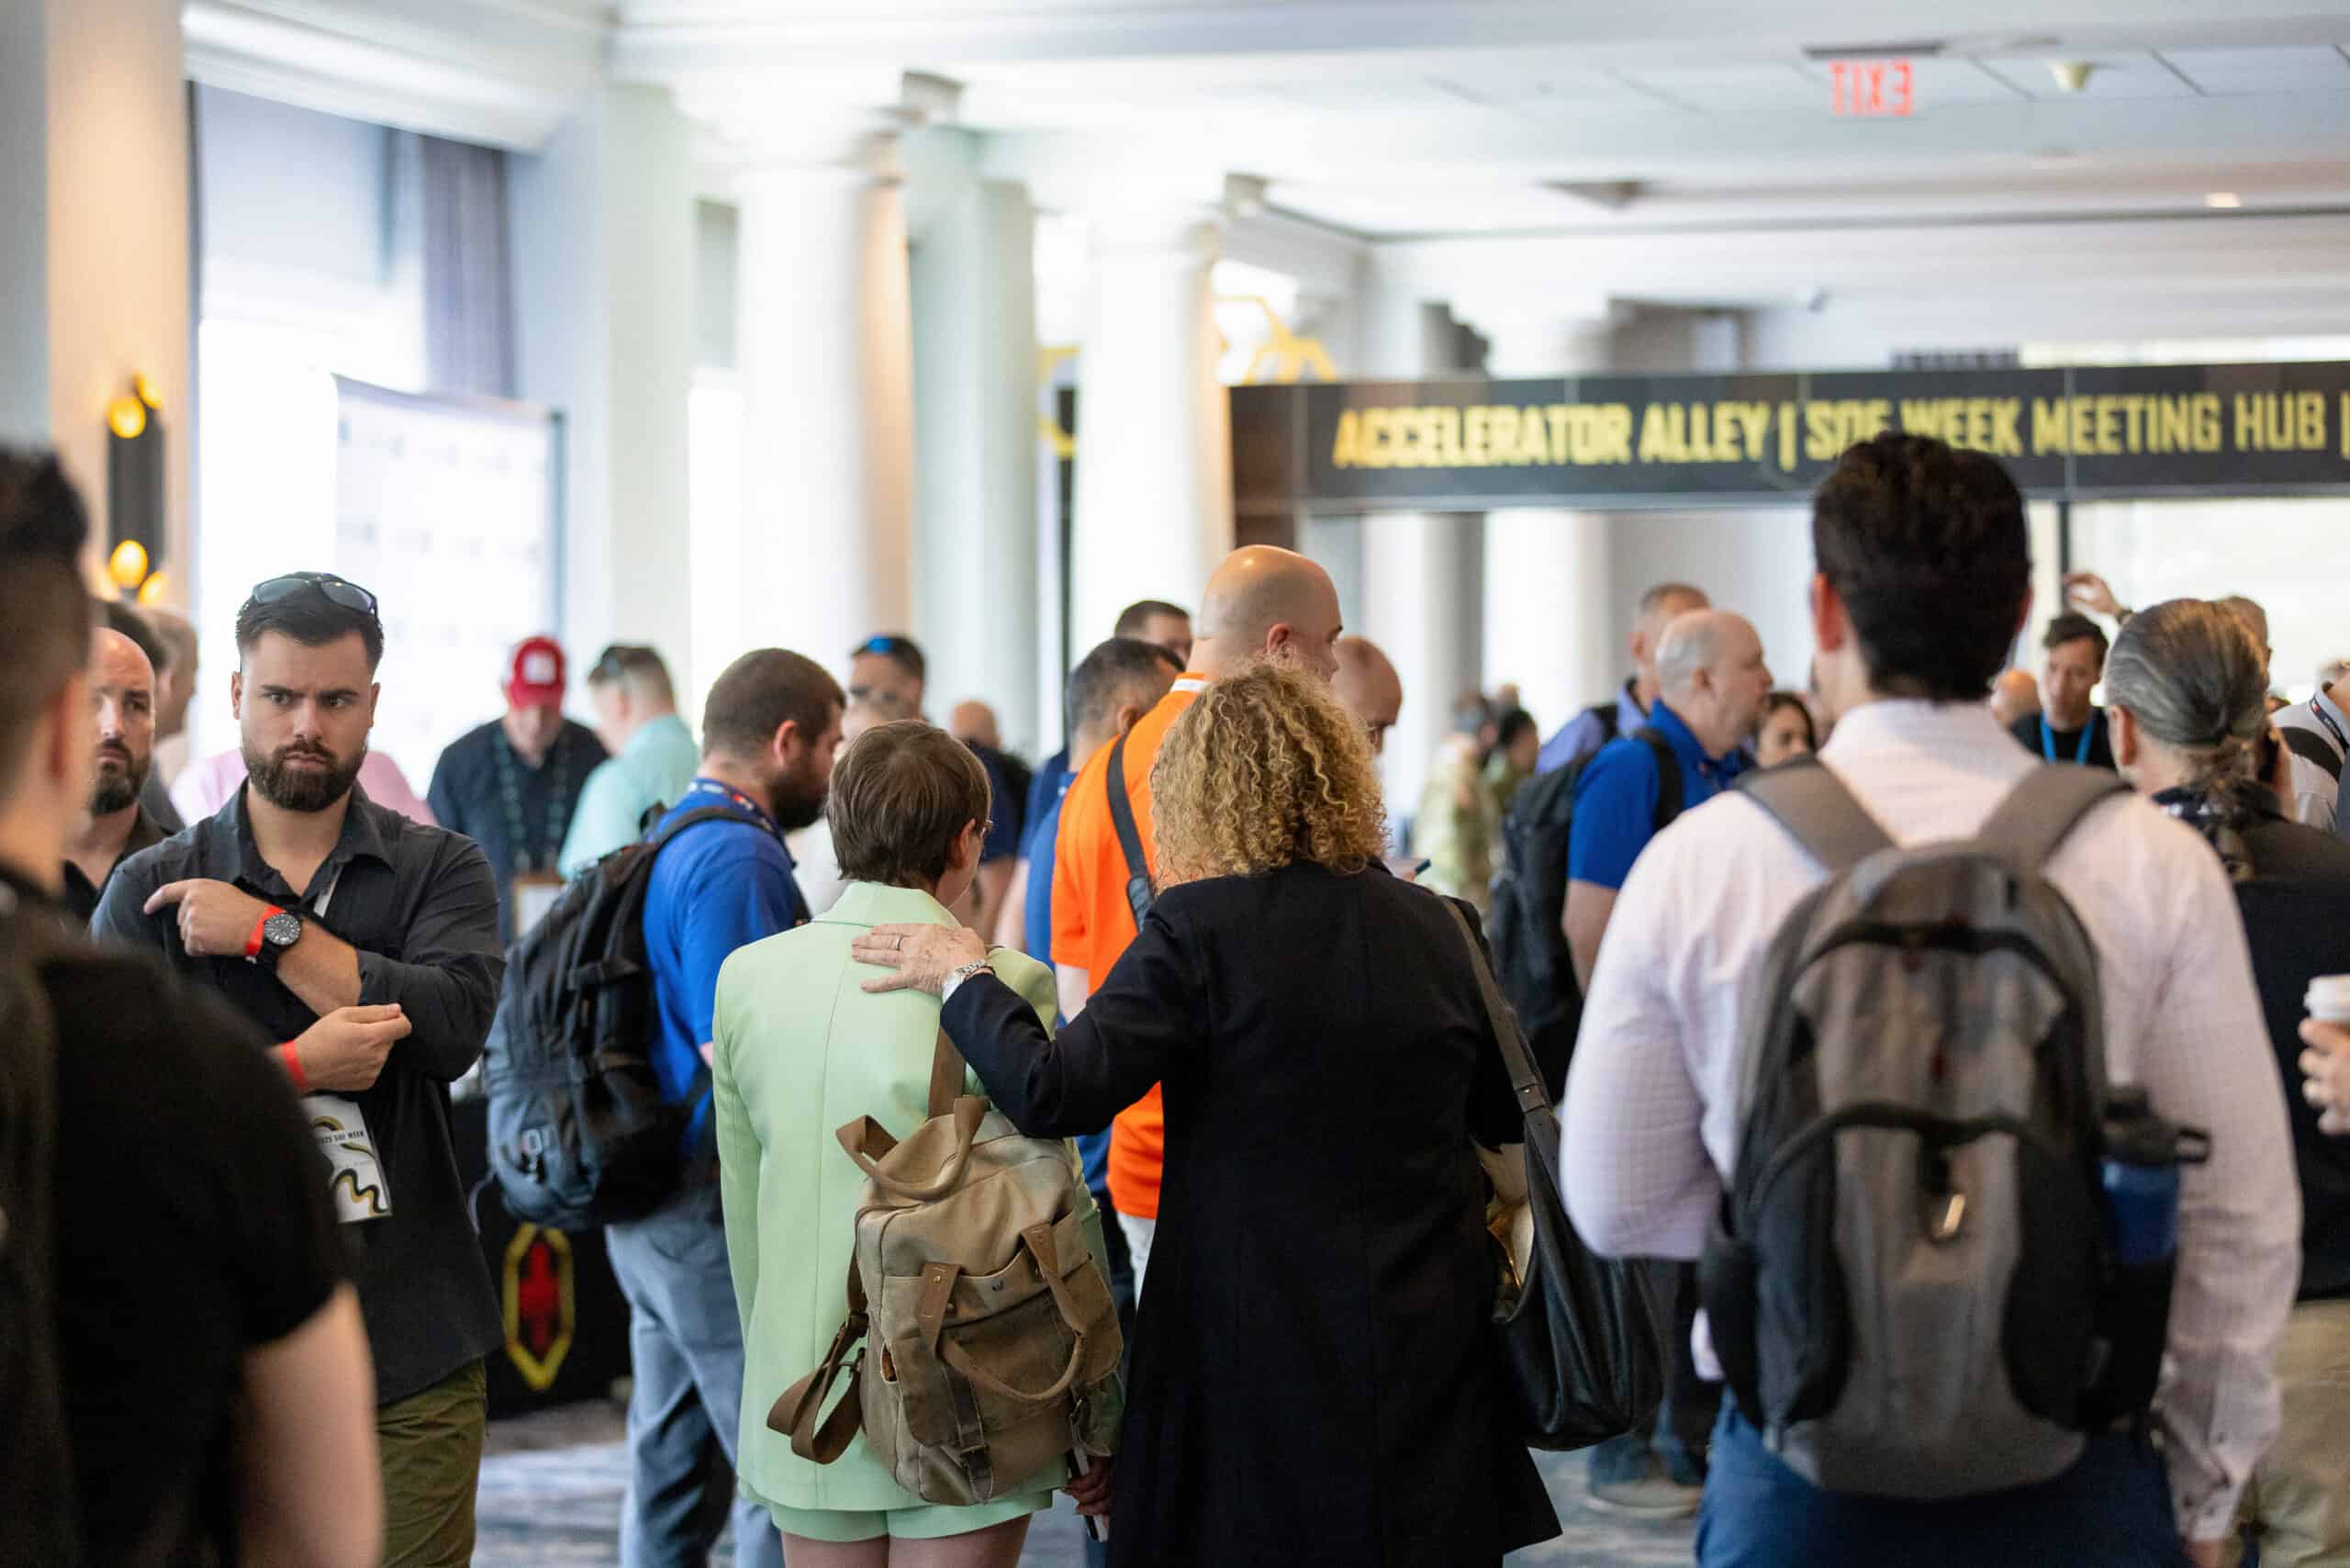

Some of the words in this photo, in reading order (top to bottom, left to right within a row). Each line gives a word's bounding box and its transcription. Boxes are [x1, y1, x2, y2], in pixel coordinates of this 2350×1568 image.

[1334, 403, 1632, 468] ACCELERATOR
[1638, 400, 1771, 463] ALLEY
[1899, 397, 2024, 456] WEEK
[2031, 393, 2221, 455] MEETING
[2234, 390, 2328, 452] HUB
